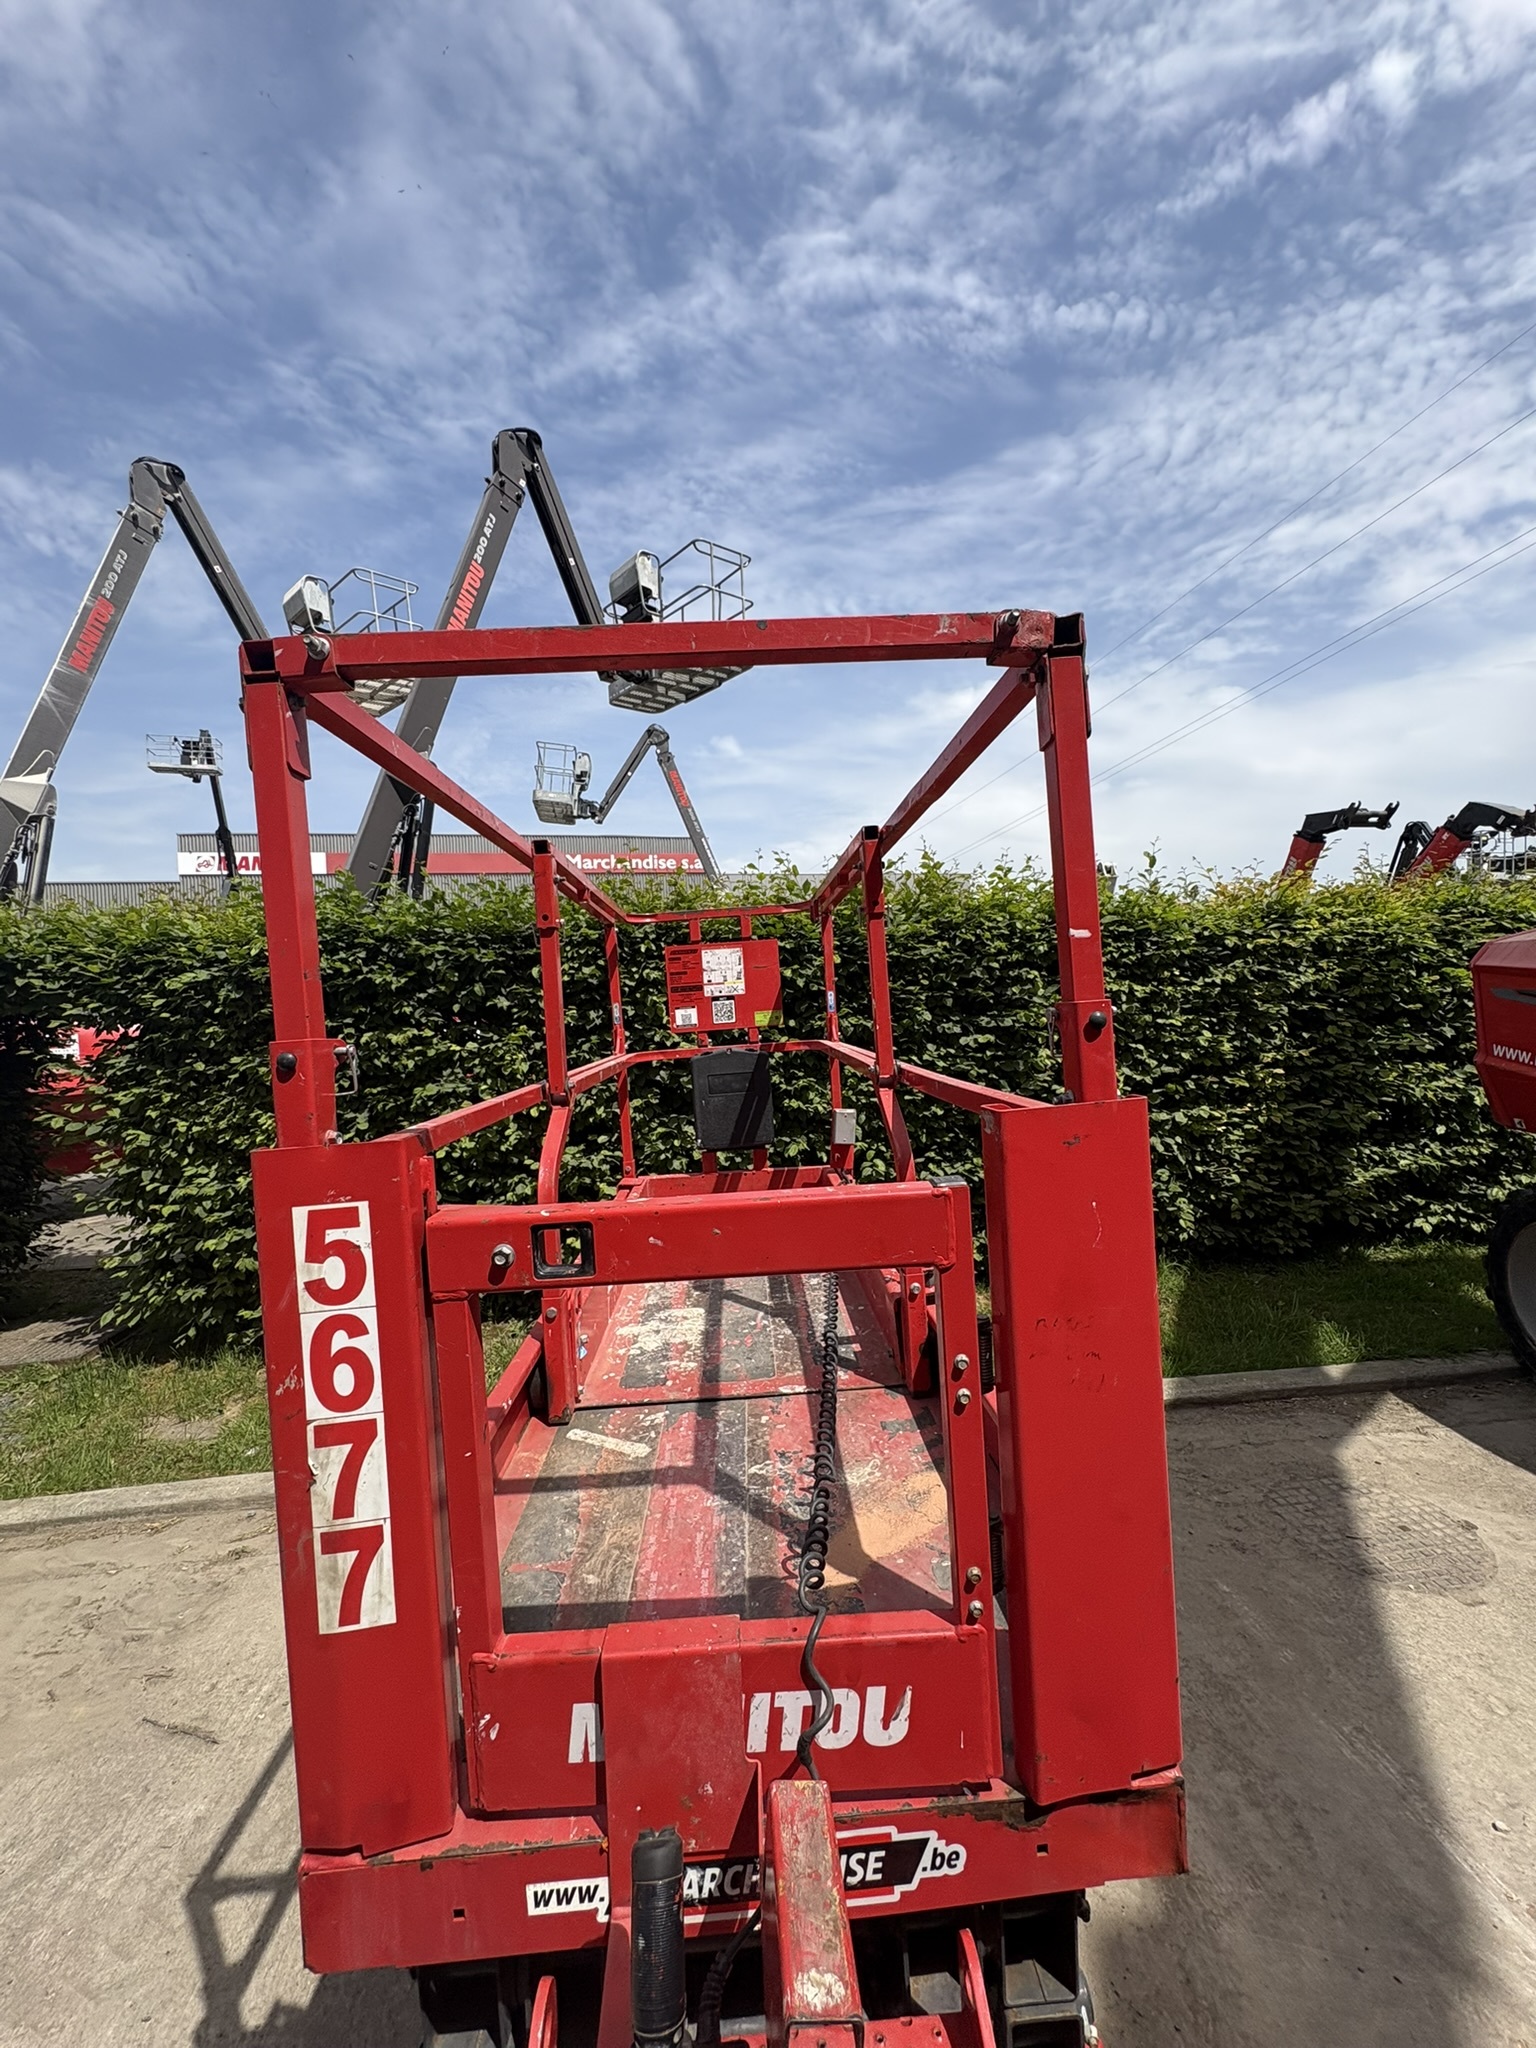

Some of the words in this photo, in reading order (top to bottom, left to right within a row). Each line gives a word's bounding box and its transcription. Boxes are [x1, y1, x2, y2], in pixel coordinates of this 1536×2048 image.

[68, 595, 116, 673] MANITOU
[101, 571, 119, 599] 200
[112, 549, 128, 574] ATJ
[446, 560, 485, 630] MANITOU
[473, 536, 489, 564] 200
[483, 513, 496, 538] ATJ
[1493, 1043, 1536, 1067] www.
[567, 1685, 913, 1764] MITOU
